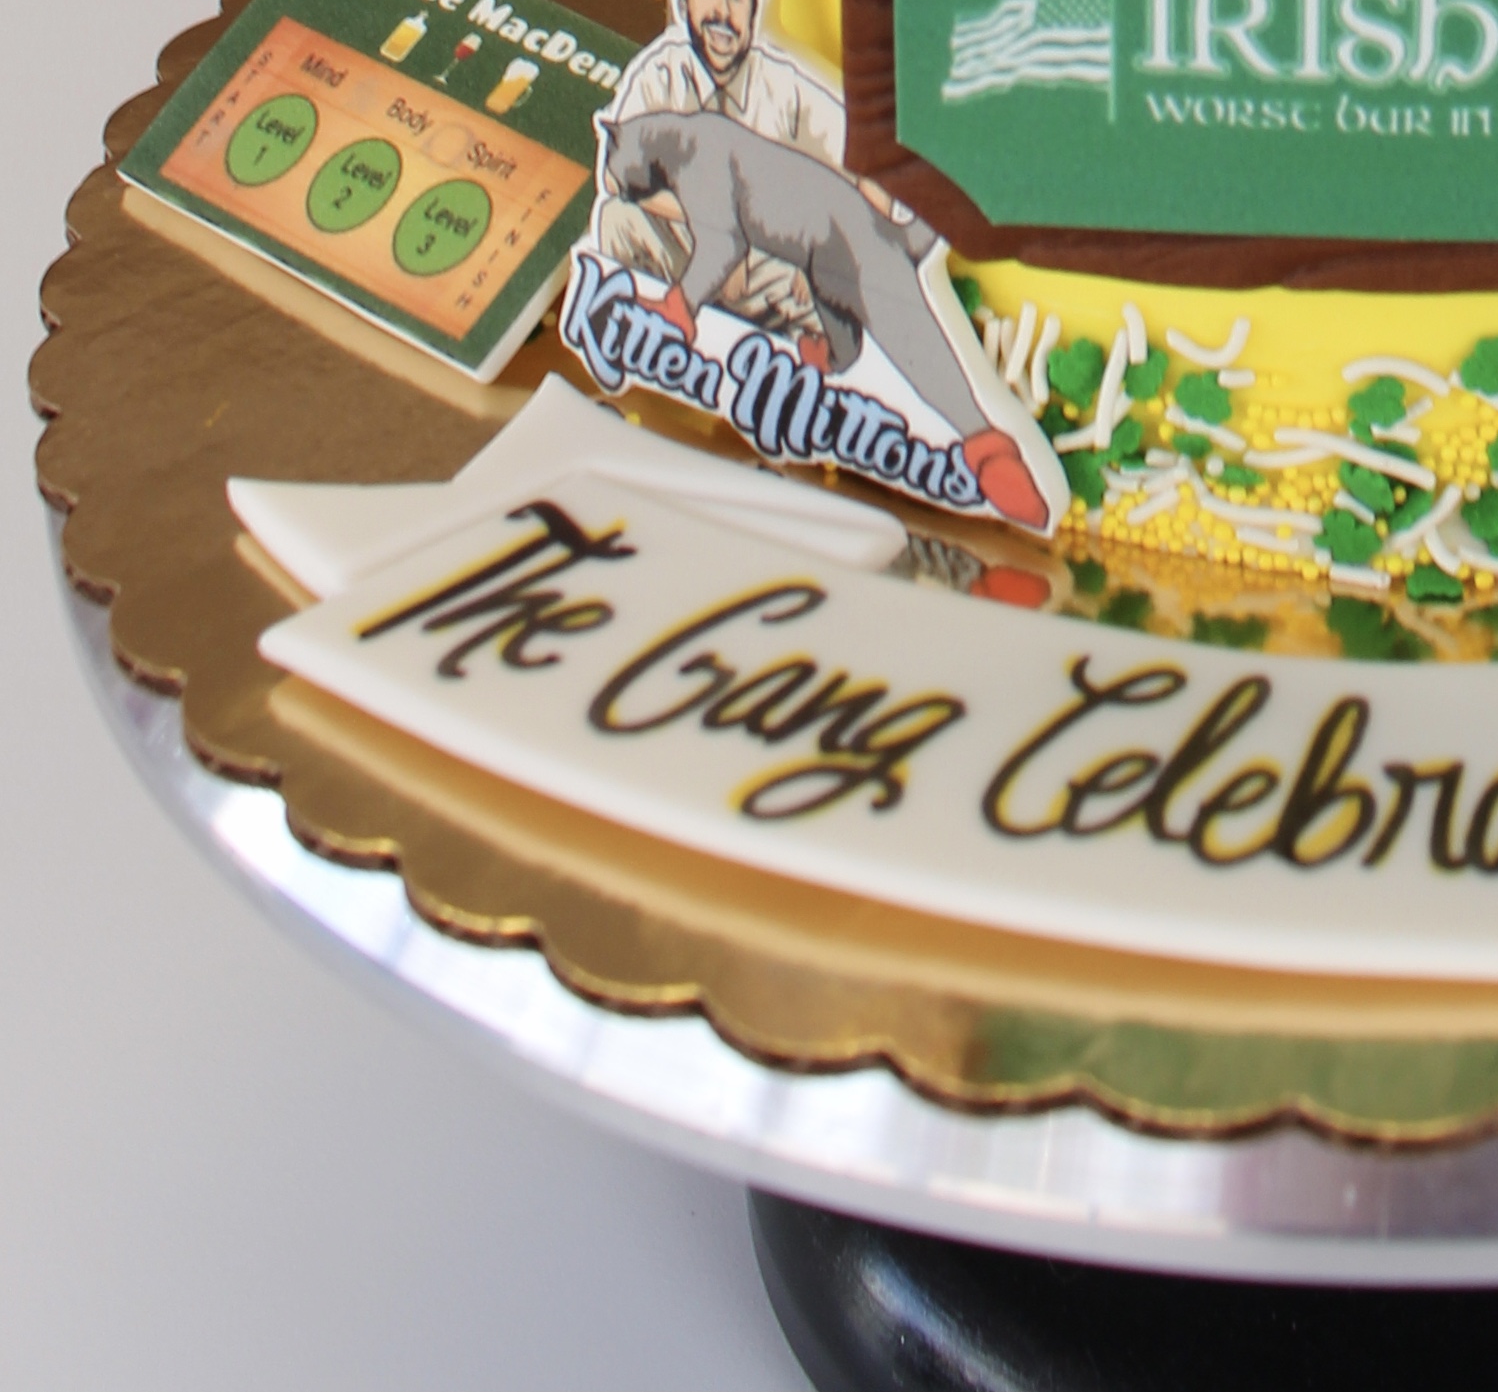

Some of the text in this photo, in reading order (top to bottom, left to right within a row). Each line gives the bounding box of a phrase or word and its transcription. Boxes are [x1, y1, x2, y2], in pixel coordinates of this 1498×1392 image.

[255, 110, 306, 145] Level
[300, 53, 518, 180] Mind Body Spirit
[253, 145, 270, 166] 1
[340, 153, 392, 190] Level
[331, 187, 353, 210] 2
[424, 196, 478, 238] Level
[416, 233, 437, 257] 3
[563, 255, 985, 507] Kitten Mittons
[356, 498, 637, 681] The
[587, 581, 966, 819] Gang
